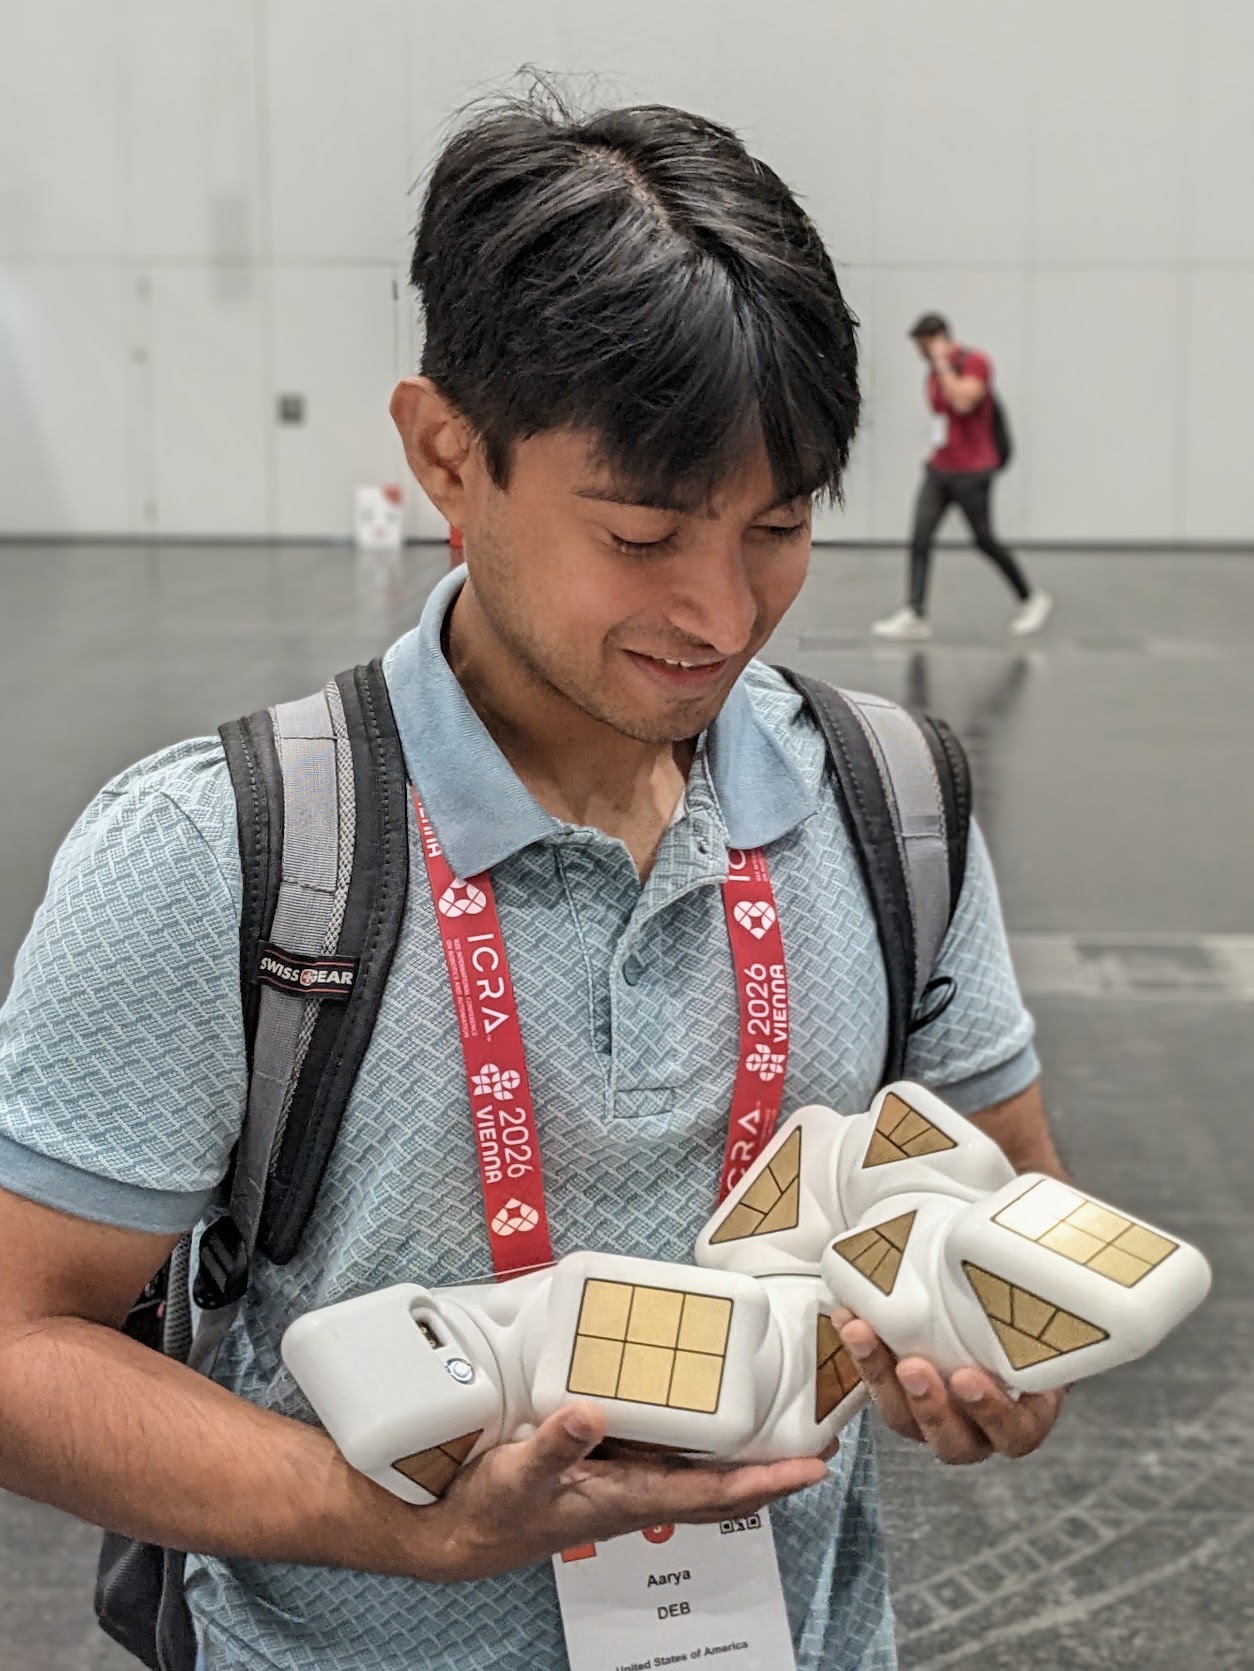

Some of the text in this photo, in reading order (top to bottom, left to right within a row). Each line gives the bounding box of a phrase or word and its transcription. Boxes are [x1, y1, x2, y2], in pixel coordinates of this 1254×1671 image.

[728, 849, 751, 882] IC
[448, 950, 460, 980] ROBOTICS
[457, 996, 470, 1038] AUTOMATION
[456, 951, 471, 996] INTERNATIONAL
[466, 996, 478, 1037] CONFERENCE
[467, 933, 510, 1035] ICRA
[743, 963, 771, 1037] 2026
[769, 964, 788, 1044] VIENNA
[476, 1105, 503, 1184] VIENNA
[498, 1107, 534, 1179] 2026
[726, 1109, 761, 1192] CRA
[647, 1569, 691, 1588] Aarya
[657, 1602, 691, 1620] DEB
[653, 1653, 688, 1667] States
[690, 1648, 701, 1660] of
[704, 1640, 749, 1657] America
